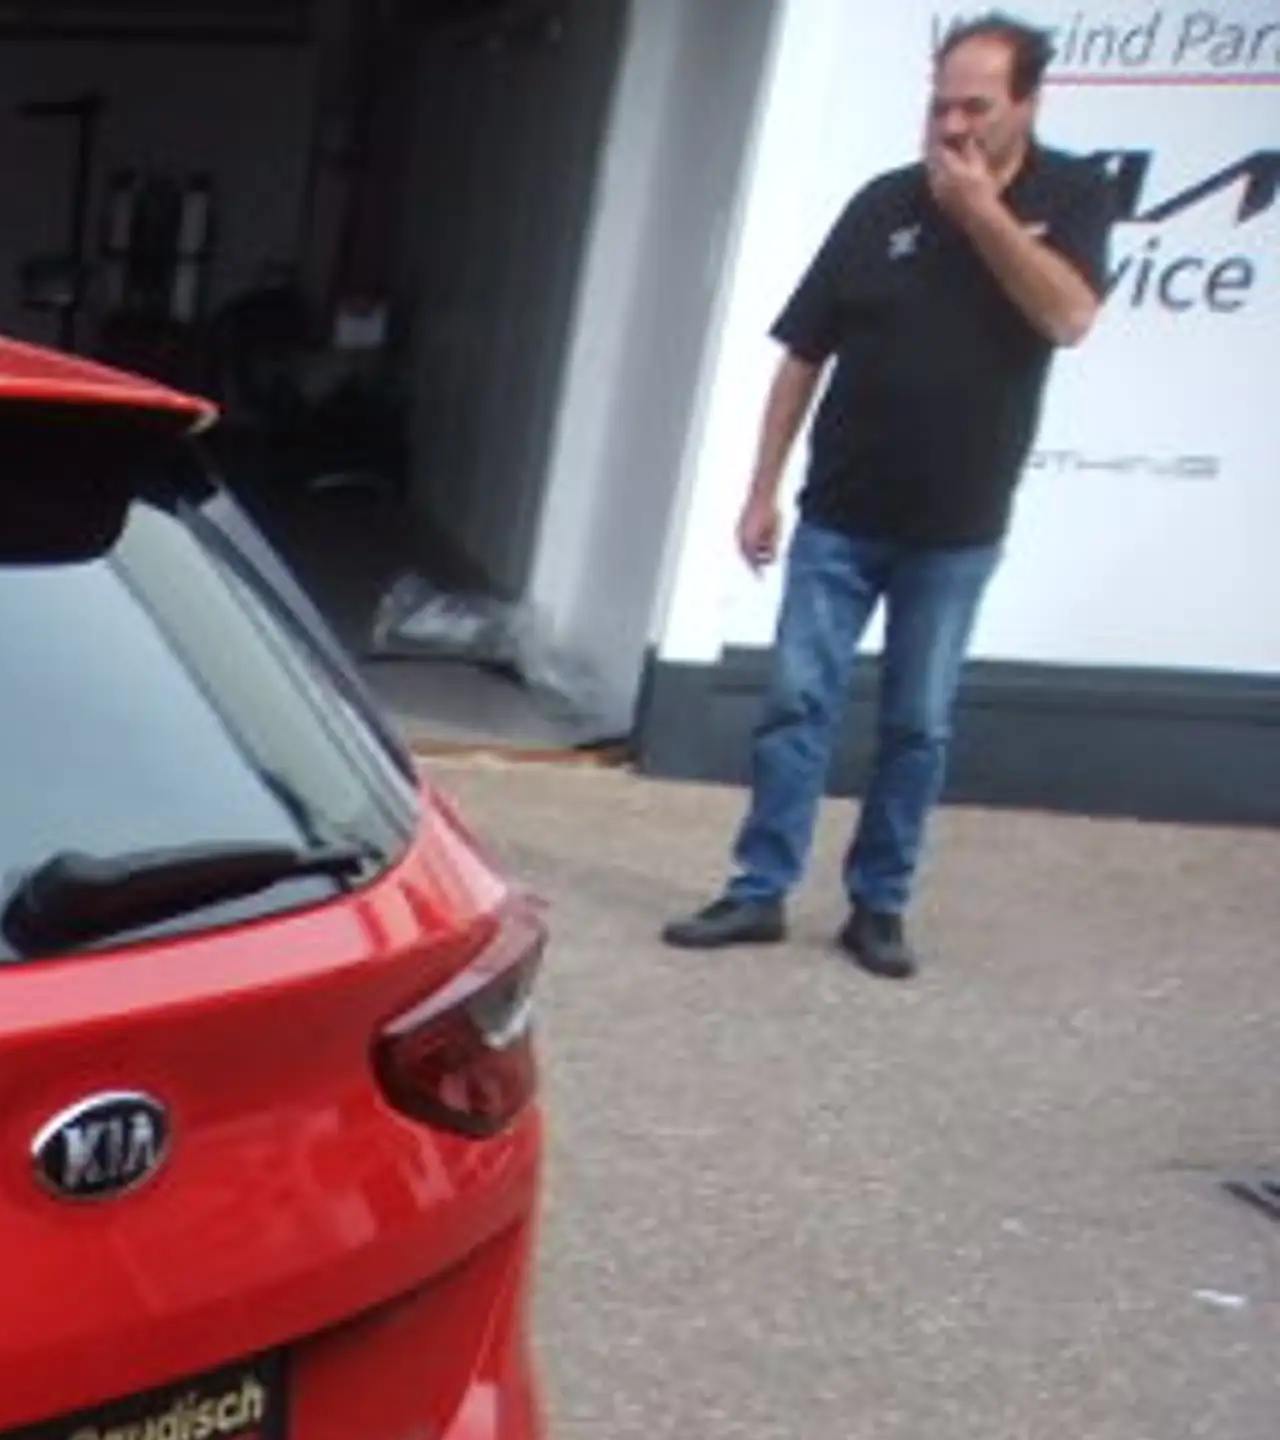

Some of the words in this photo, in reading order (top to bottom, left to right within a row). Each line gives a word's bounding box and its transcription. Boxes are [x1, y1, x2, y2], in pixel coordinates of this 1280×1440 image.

[1172, 9, 1280, 68] Par
[1100, 237, 1255, 313] vice
[62, 1110, 158, 1188] KIA
